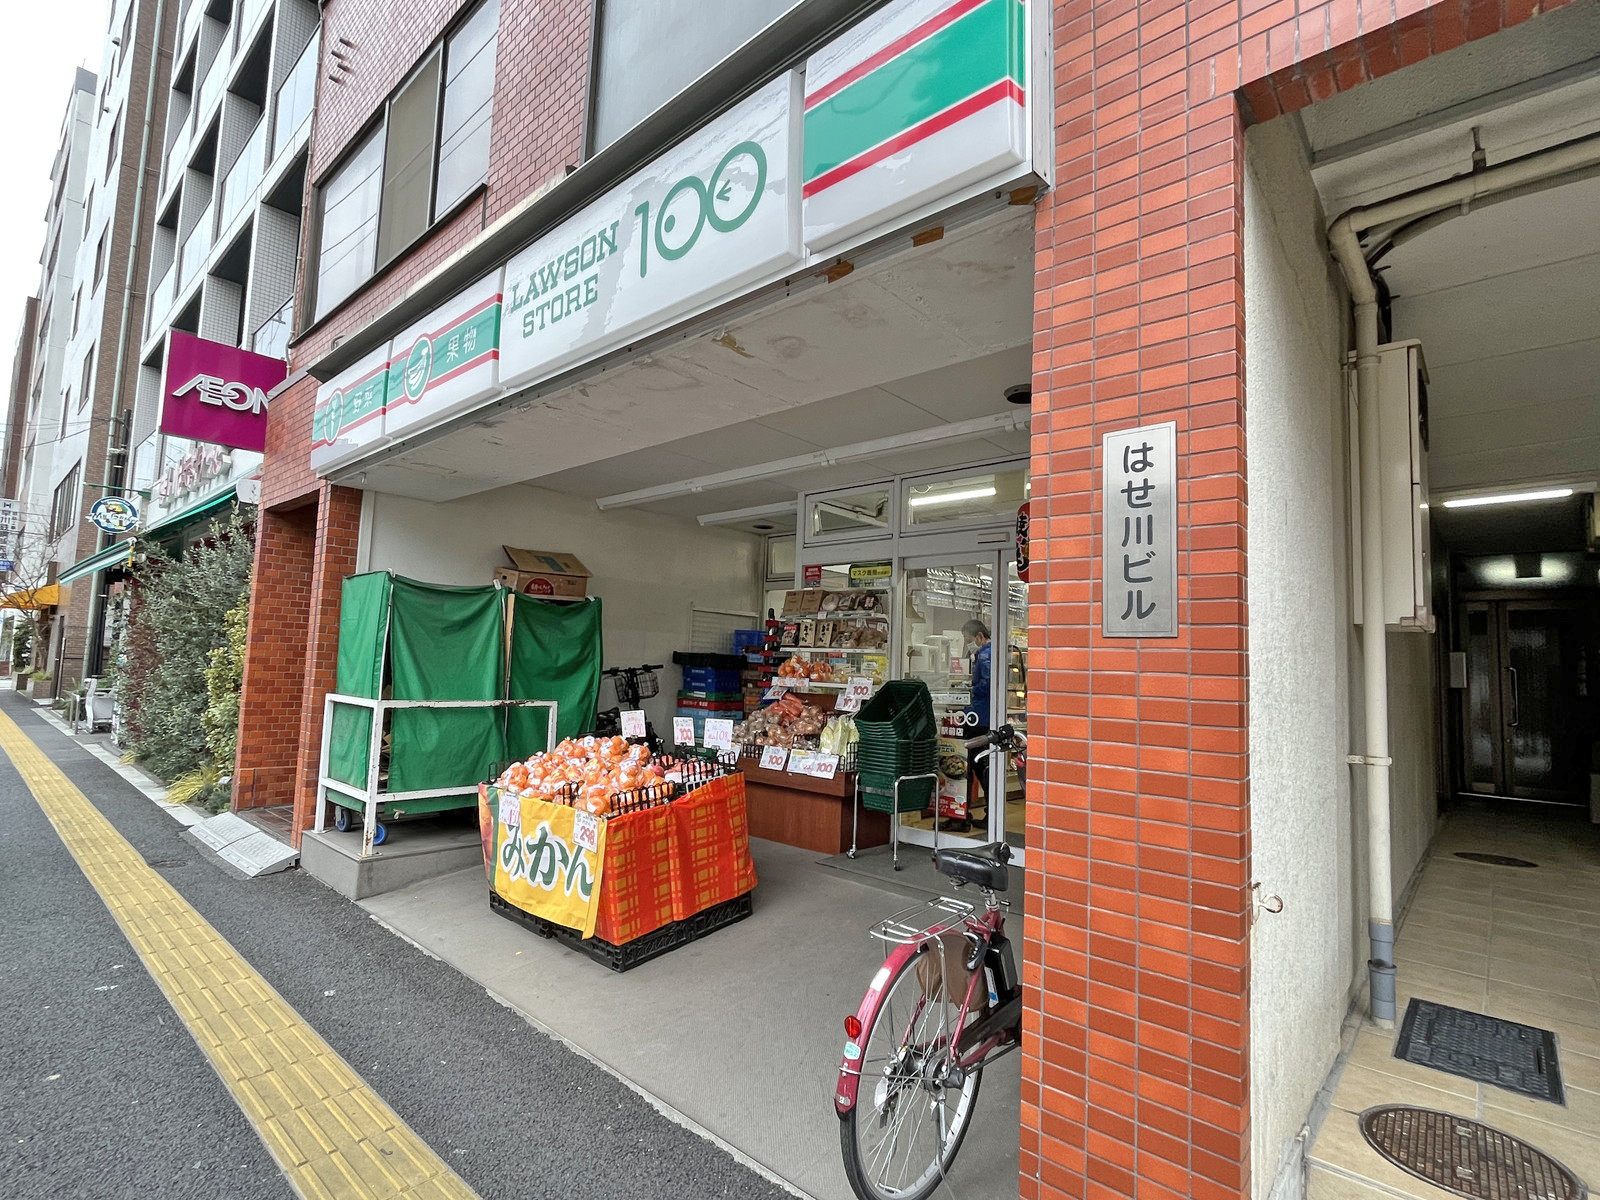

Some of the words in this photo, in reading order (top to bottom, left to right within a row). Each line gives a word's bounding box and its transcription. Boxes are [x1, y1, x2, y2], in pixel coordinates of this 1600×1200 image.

[510, 220, 619, 313] LAWSON
[635, 140, 768, 279] 100
[522, 276, 599, 338] STORE
[446, 326, 477, 363] 果物
[1121, 441, 1157, 621] はせ川ビル
[853, 685, 869, 696] 100
[680, 728, 693, 741] 100
[767, 755, 783, 766] 100
[816, 762, 833, 773] 100
[580, 825, 595, 846] 298
[502, 824, 594, 897] みかん
